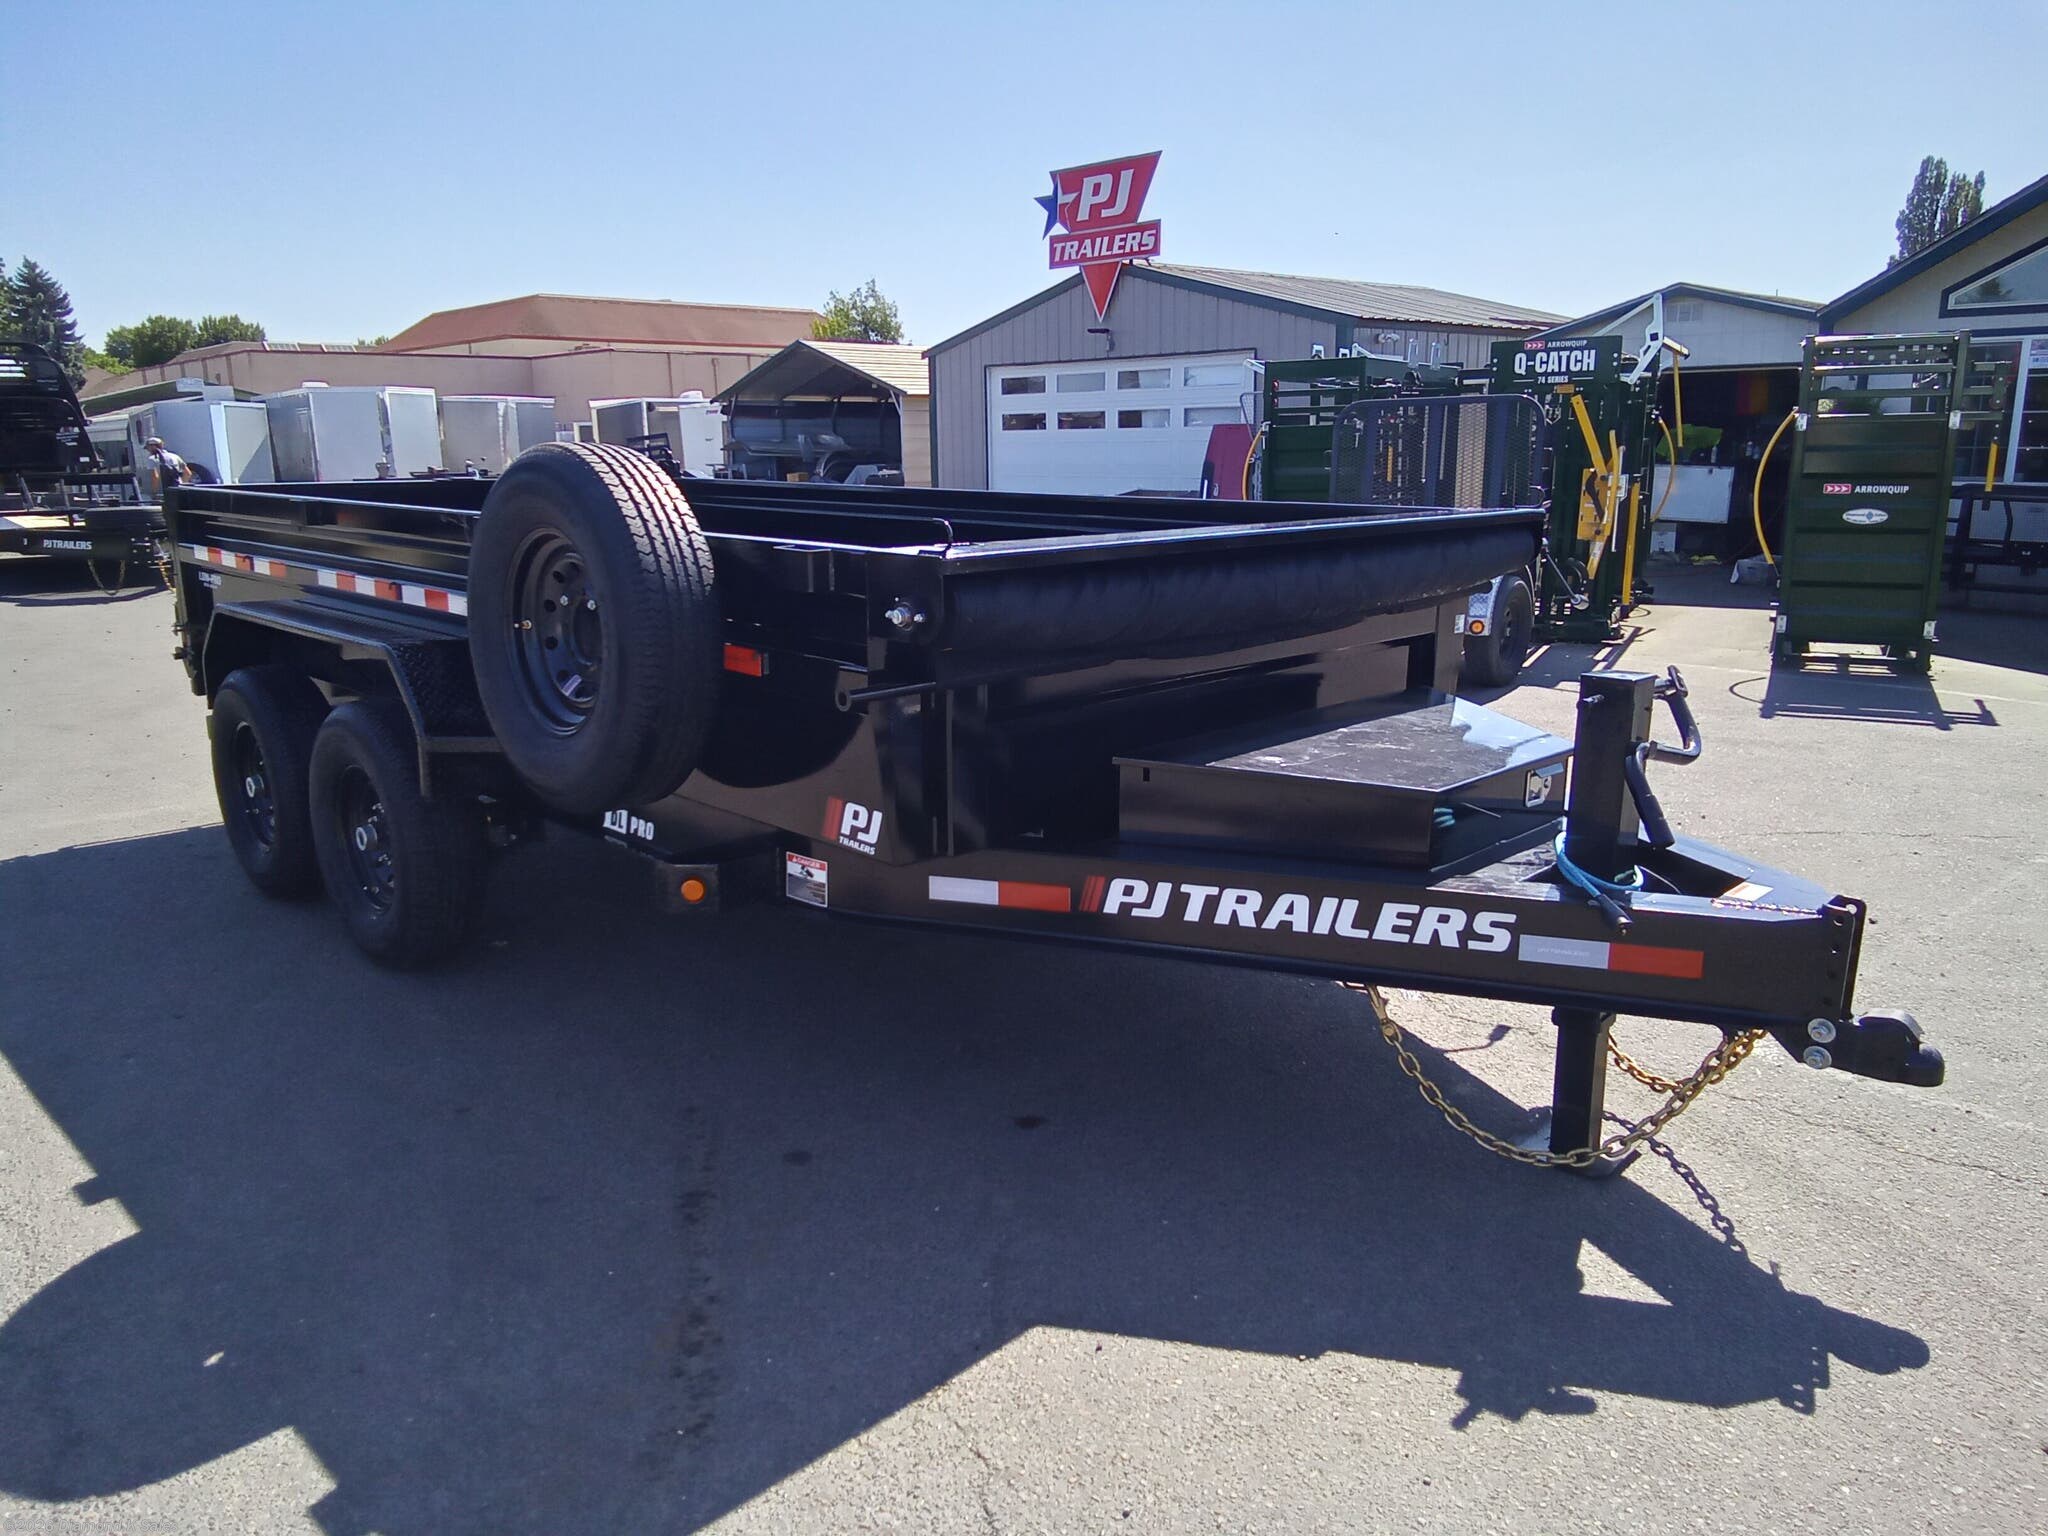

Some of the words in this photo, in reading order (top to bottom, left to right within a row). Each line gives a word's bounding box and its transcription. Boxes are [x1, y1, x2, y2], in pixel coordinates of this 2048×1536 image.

[1076, 168, 1135, 222] PJ
[1053, 229, 1157, 262] TRAILERS
[1547, 339, 1588, 348] ARROWQUIP
[1513, 349, 1596, 375] Q-CATCH
[1547, 375, 1569, 383] SERIES
[1854, 485, 1910, 494] ARROWQUIP
[629, 815, 655, 840] PRO
[840, 802, 883, 844] PJ
[839, 836, 876, 855] TRAILERS
[1102, 877, 1173, 918] PJ
[1180, 883, 1518, 952] TRAILERS
